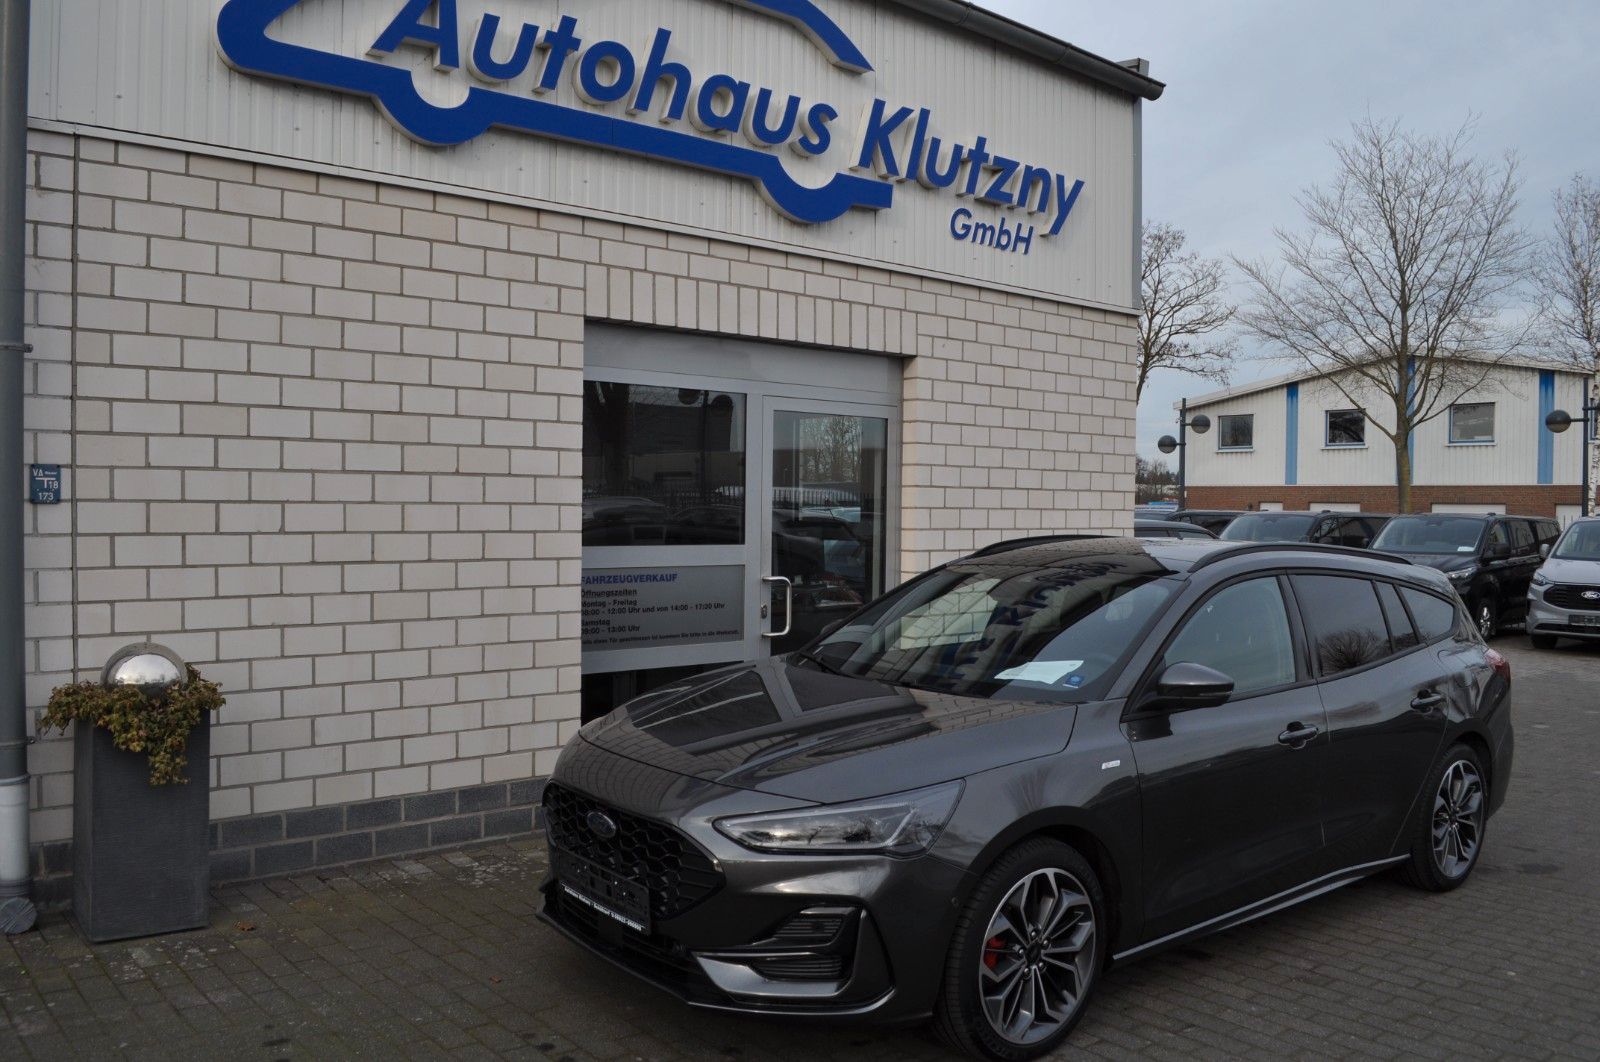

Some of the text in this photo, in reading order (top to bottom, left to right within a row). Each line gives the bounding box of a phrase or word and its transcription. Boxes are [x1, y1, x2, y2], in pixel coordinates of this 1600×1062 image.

[372, 0, 1084, 235] Autohaus Klutzny
[950, 207, 1034, 255] GmbH
[612, 599, 638, 607] Freitag
[608, 607, 626, 615] 12:00
[628, 606, 641, 614] Uhr
[628, 624, 641, 632] Uhr
